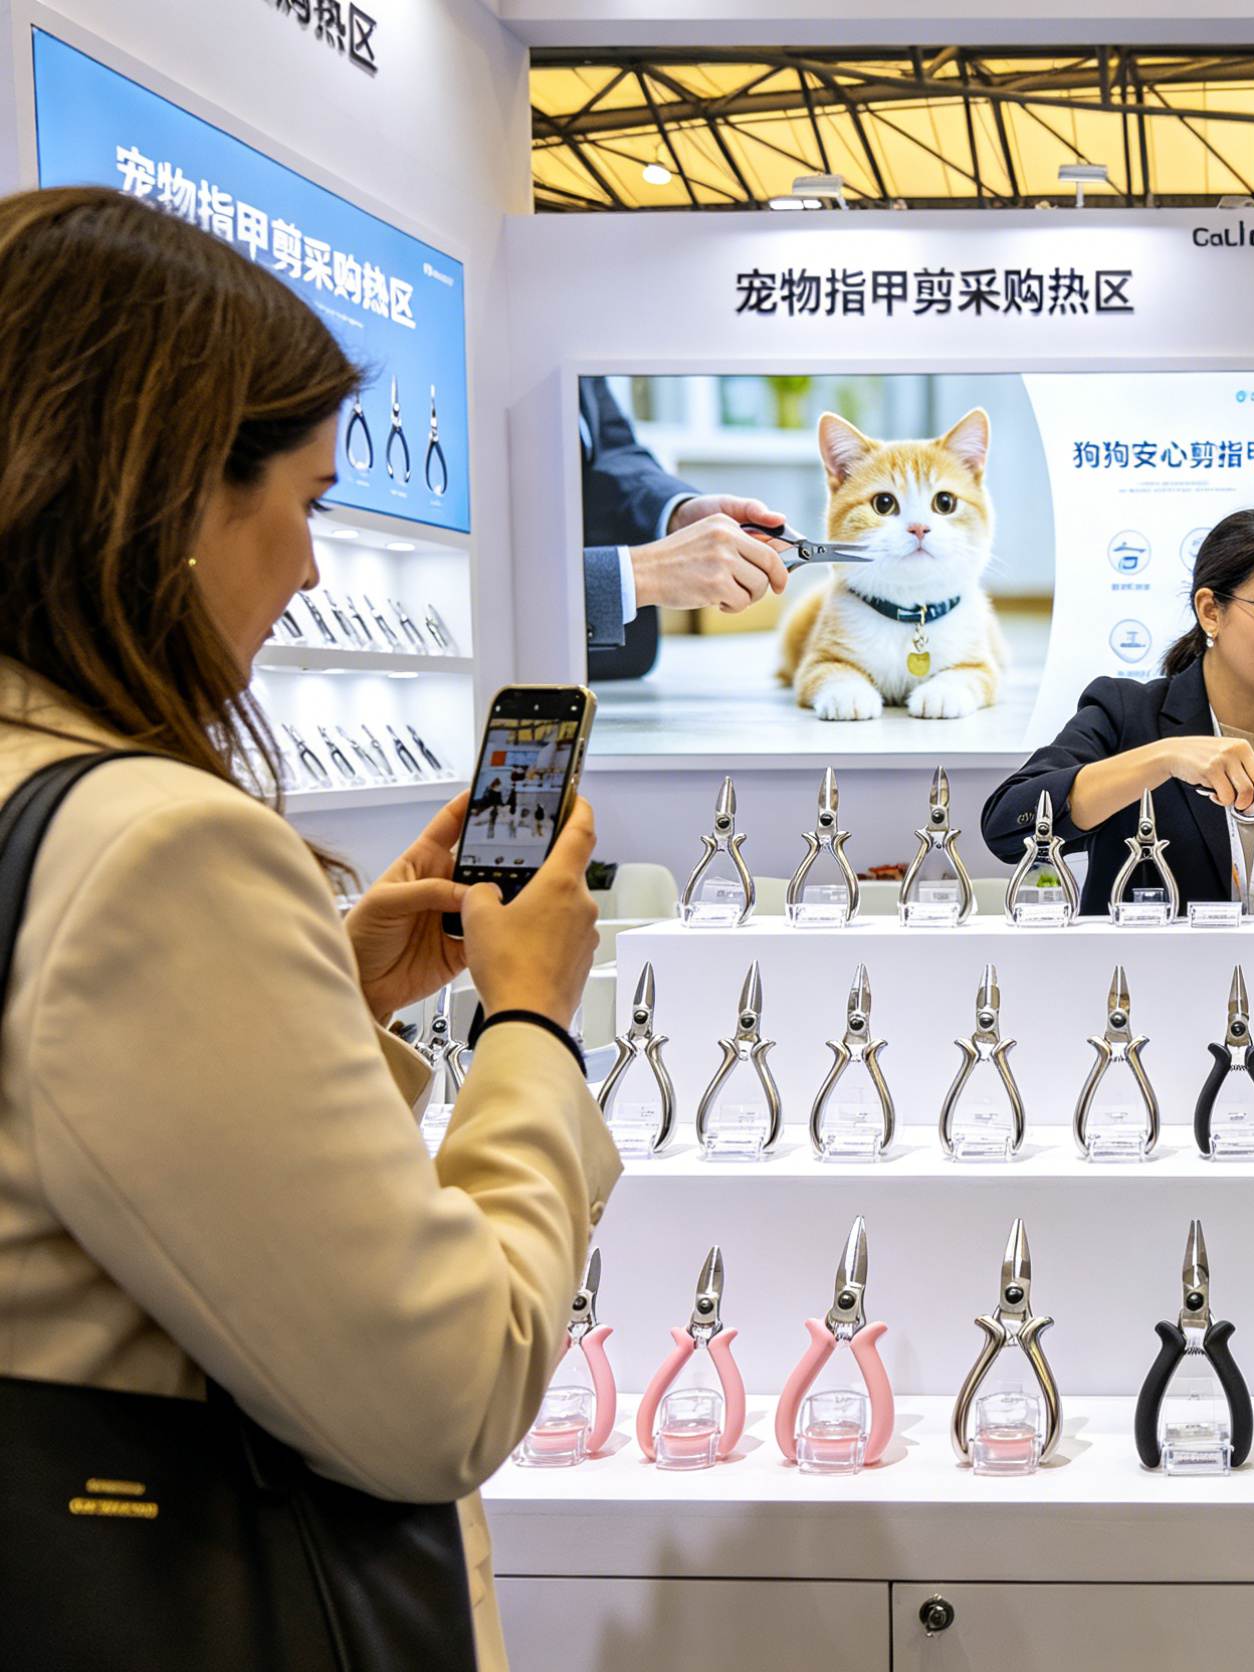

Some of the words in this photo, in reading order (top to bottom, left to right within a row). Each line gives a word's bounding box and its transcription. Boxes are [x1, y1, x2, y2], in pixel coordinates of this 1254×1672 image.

[116, 145, 416, 329] 宠物指甲剪采购热区
[735, 267, 1136, 316] 宠物指甲剪采购热区
